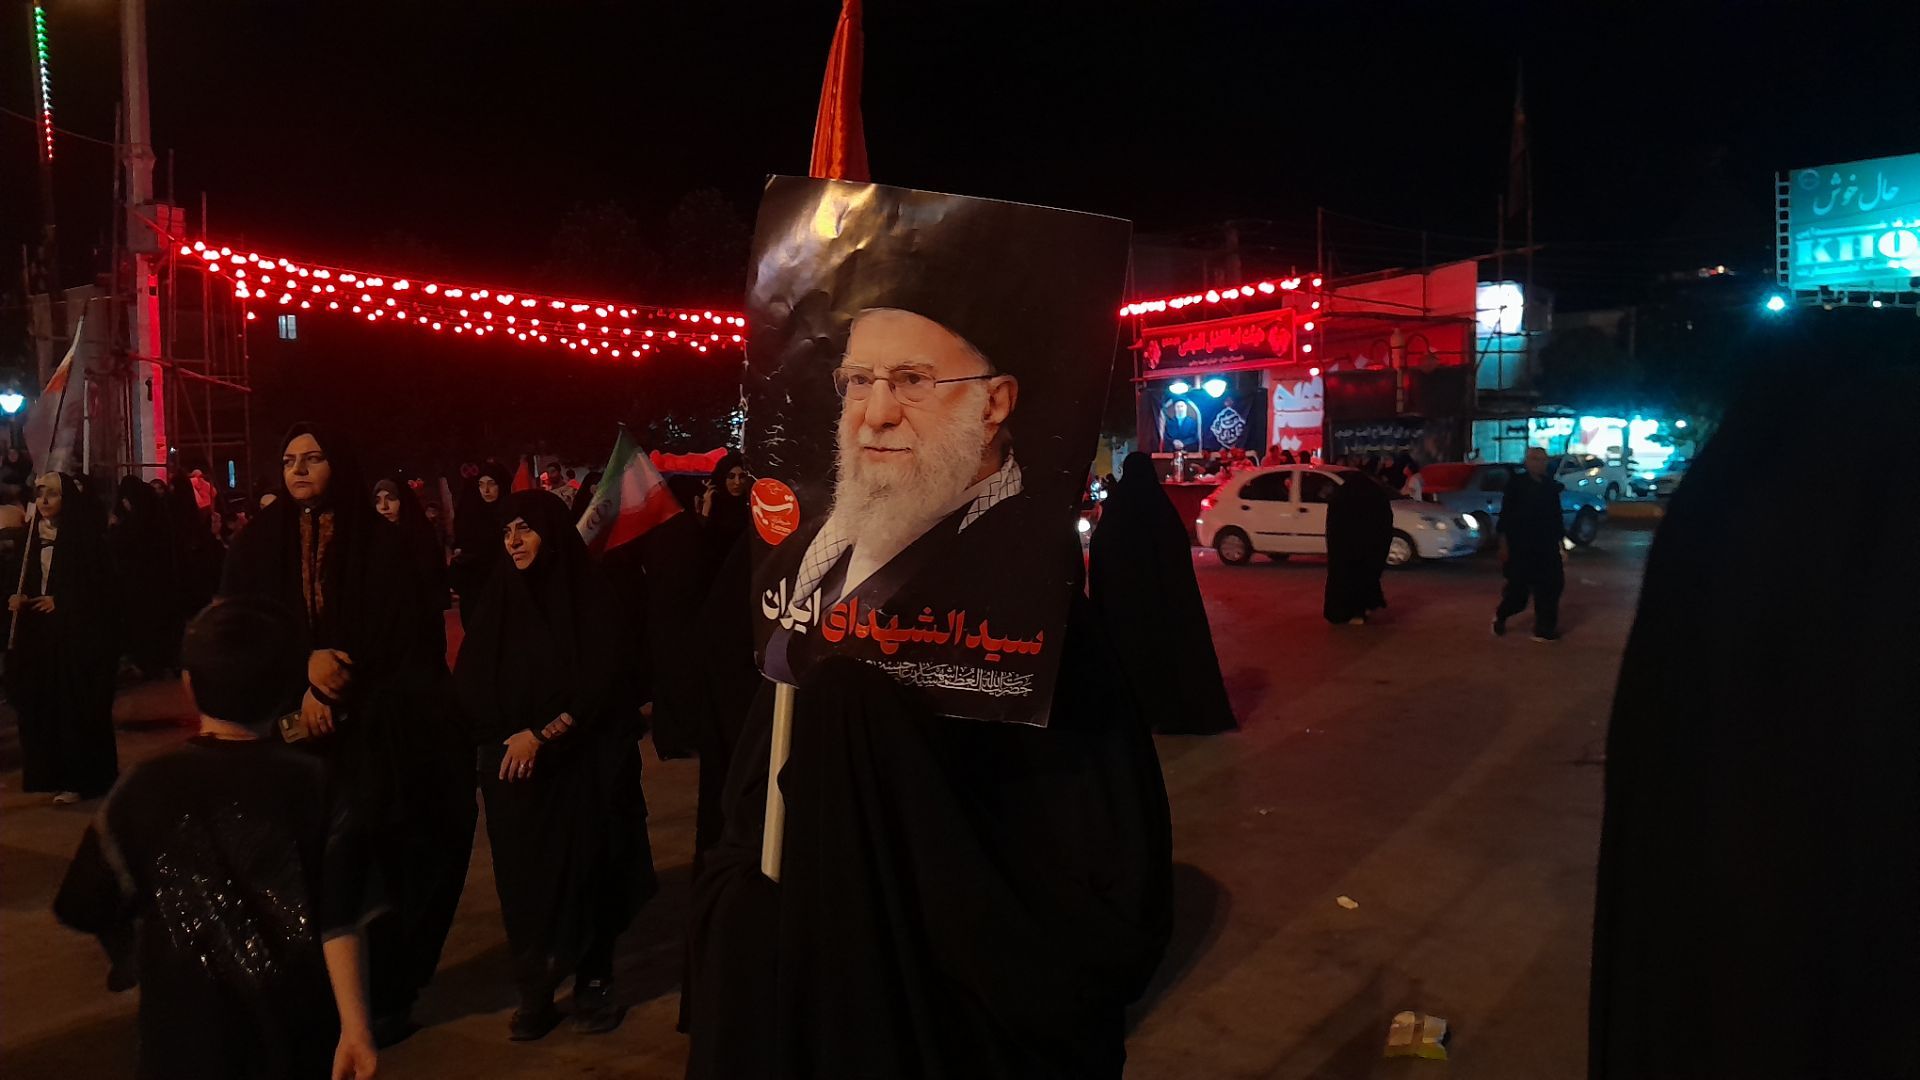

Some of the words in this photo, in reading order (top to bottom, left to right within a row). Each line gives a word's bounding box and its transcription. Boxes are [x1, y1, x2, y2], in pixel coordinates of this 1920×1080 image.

[1813, 171, 1858, 216] خوش
[1859, 171, 1899, 211] حال
[761, 577, 821, 635] ایران
